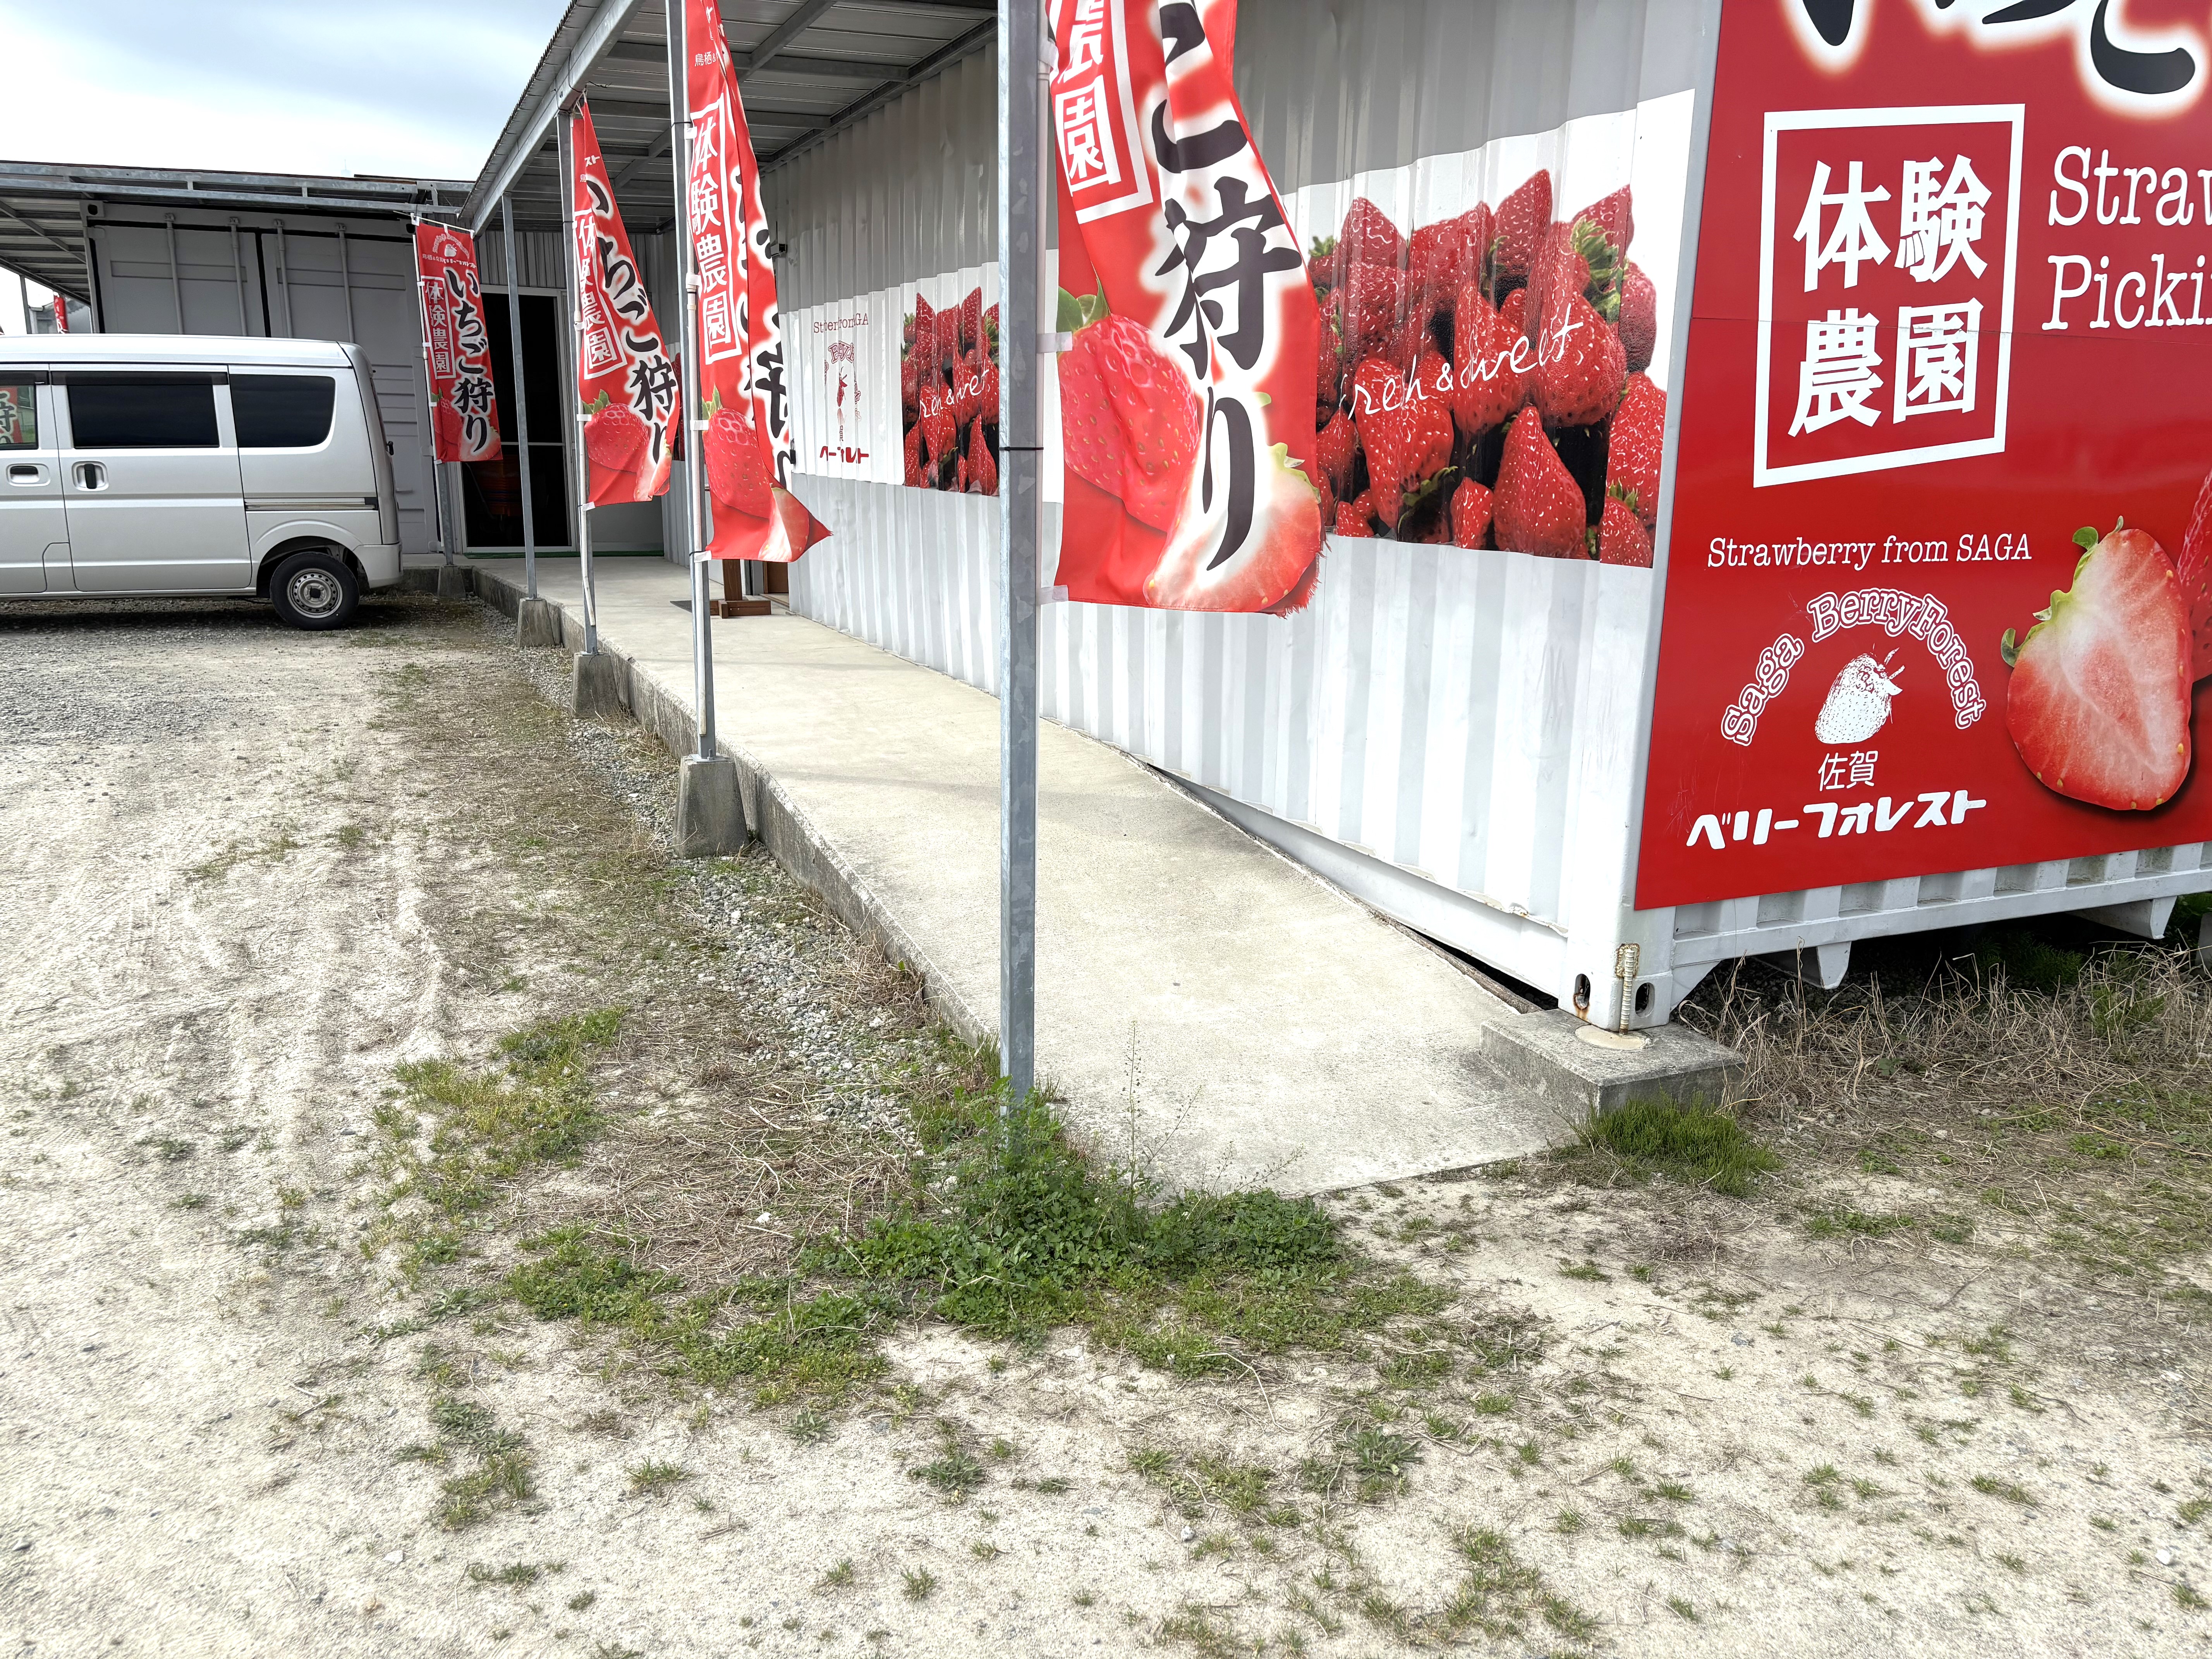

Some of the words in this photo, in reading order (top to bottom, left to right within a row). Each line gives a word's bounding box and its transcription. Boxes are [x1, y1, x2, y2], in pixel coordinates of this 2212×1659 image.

[690, 121, 728, 350] 体験農園
[1793, 154, 1992, 293] 体験
[426, 281, 450, 373] 体験農園
[2042, 254, 2212, 330] Picki
[446, 270, 494, 452] いちご狩り
[1436, 362, 1454, 392] &
[1788, 297, 1984, 438] 農園
[1708, 537, 1876, 570] Strawberry
[1881, 534, 1949, 564] from
[1956, 533, 2032, 562] SAGA
[1721, 633, 1805, 746] Saga
[1818, 750, 1878, 792] 佐賀
[1686, 789, 1987, 850] ベリーフォレスト
